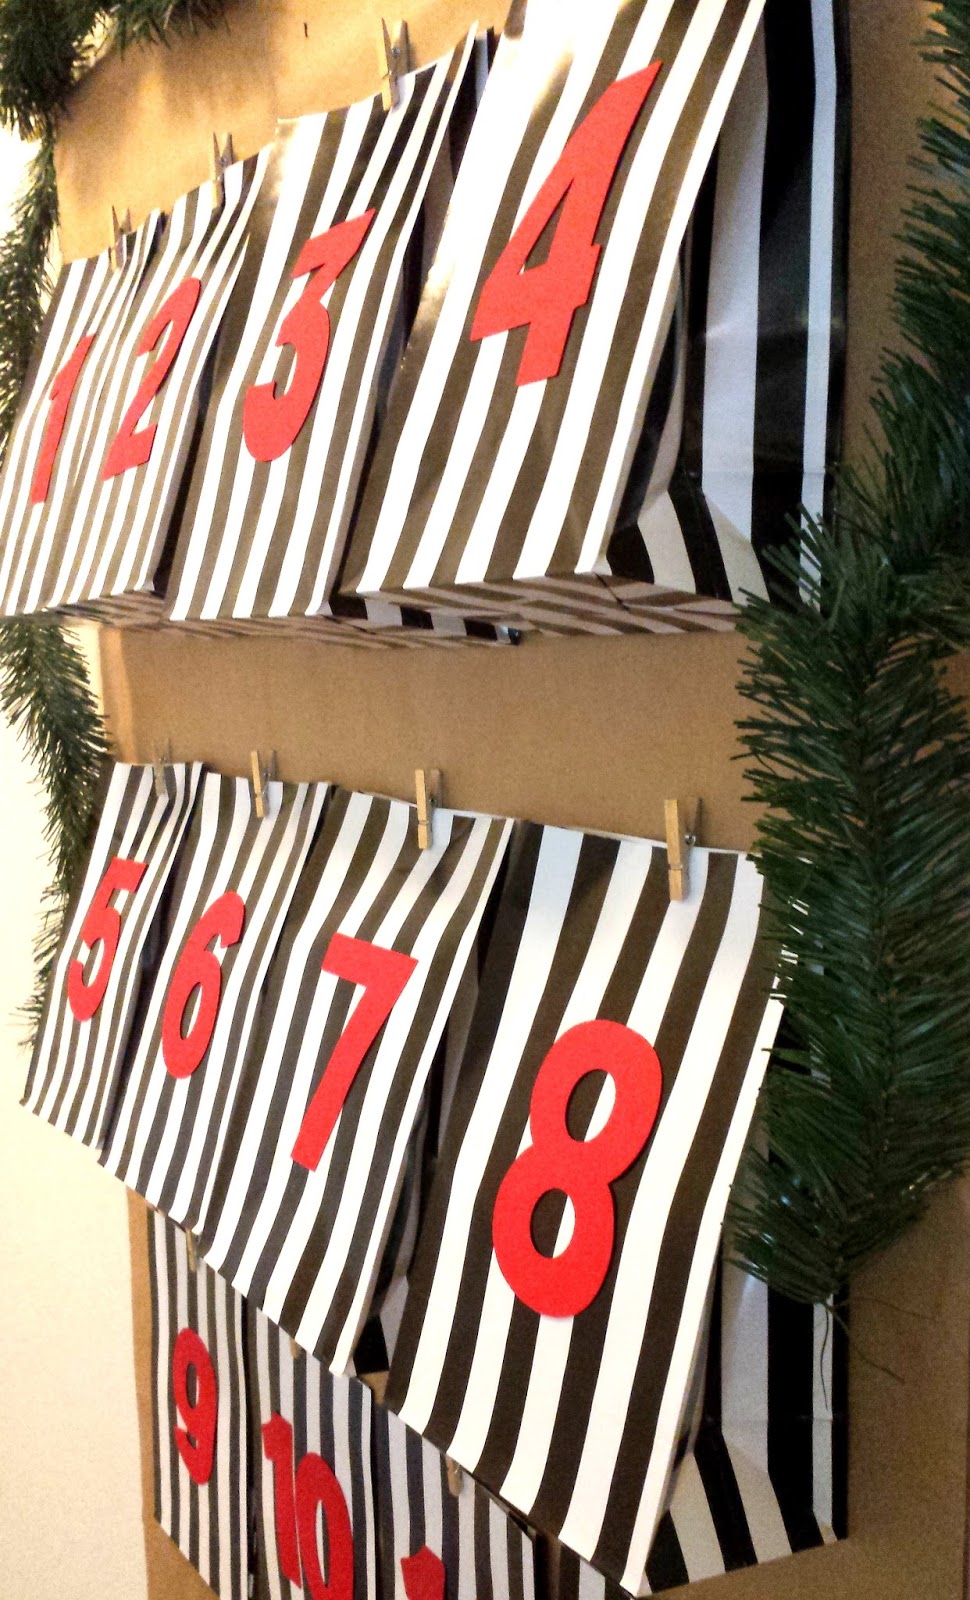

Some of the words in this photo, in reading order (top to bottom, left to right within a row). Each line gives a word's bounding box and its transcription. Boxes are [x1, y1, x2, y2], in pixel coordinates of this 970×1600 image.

[469, 61, 662, 387] 4
[31, 335, 96, 504] 1
[102, 278, 202, 479] 2
[242, 208, 378, 462] 3
[66, 856, 146, 1020] 5
[161, 891, 246, 1078] 6
[291, 933, 418, 1172] 7
[492, 1018, 663, 1319] 8
[171, 1328, 218, 1485] 9
[260, 1411, 355, 1600] 10
